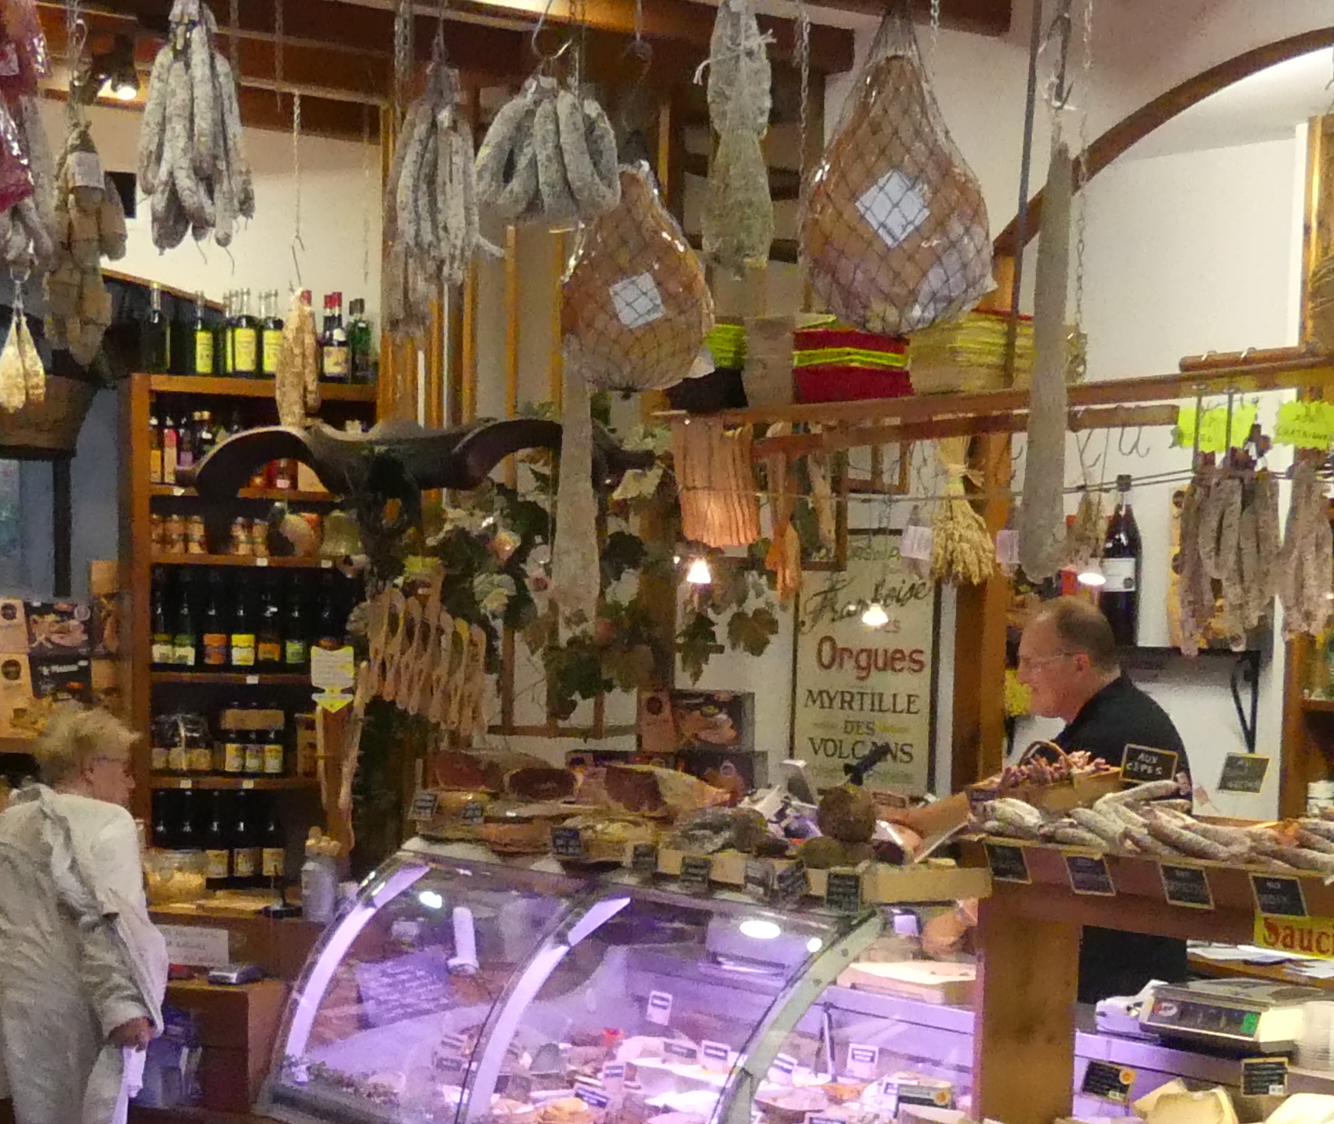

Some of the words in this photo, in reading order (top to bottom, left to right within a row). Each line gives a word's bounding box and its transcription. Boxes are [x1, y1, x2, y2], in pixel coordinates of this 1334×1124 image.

[817, 635, 926, 681] Orgues
[804, 689, 920, 715] MYRTILLE
[843, 719, 876, 736] DES
